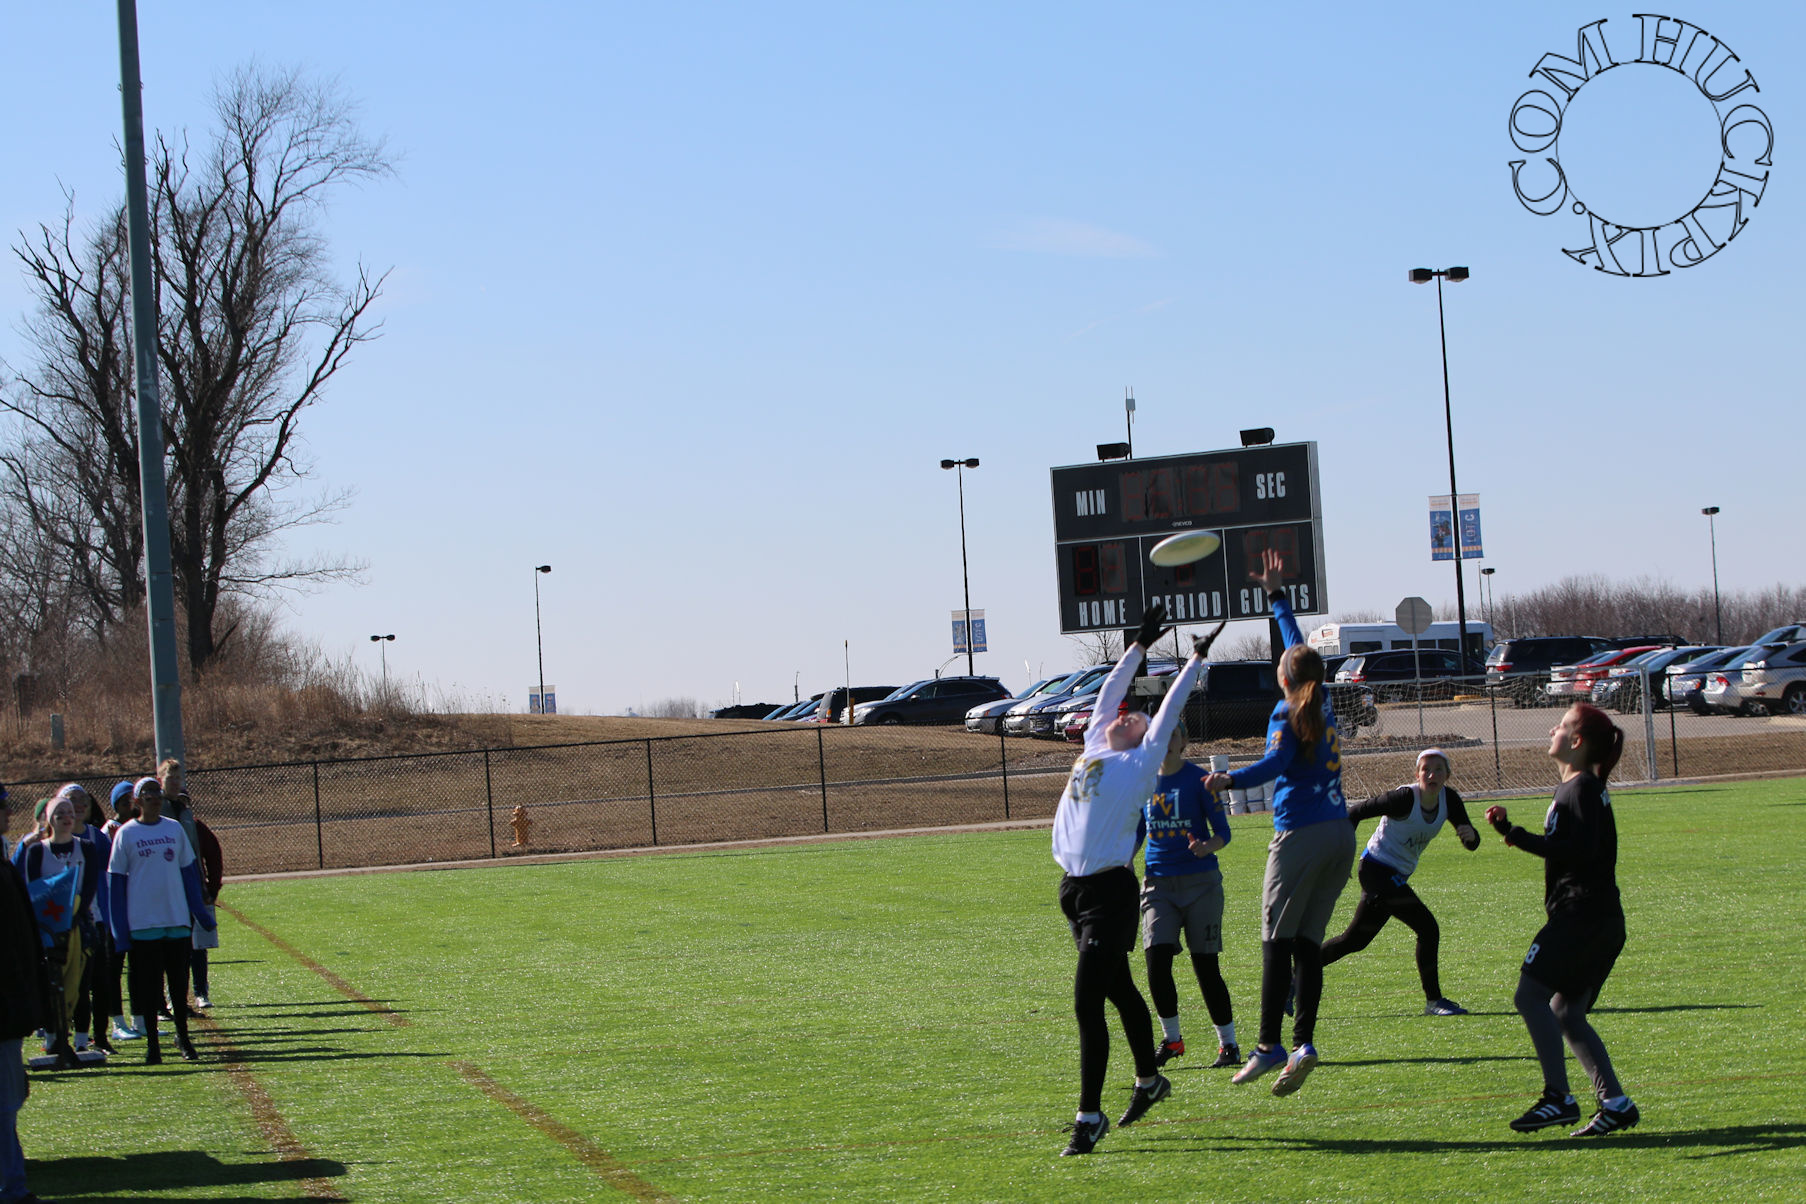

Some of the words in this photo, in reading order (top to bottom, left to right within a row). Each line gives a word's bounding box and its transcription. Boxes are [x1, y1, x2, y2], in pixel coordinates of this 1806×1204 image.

[1256, 471, 1286, 499] SEC
[1075, 489, 1106, 517] MIN
[1079, 599, 1127, 627] HOME
[1239, 584, 1310, 615] GUTS
[1145, 820, 1192, 830] LTIMATE
[136, 835, 177, 849] thumbs
[1524, 943, 1541, 965] 8
